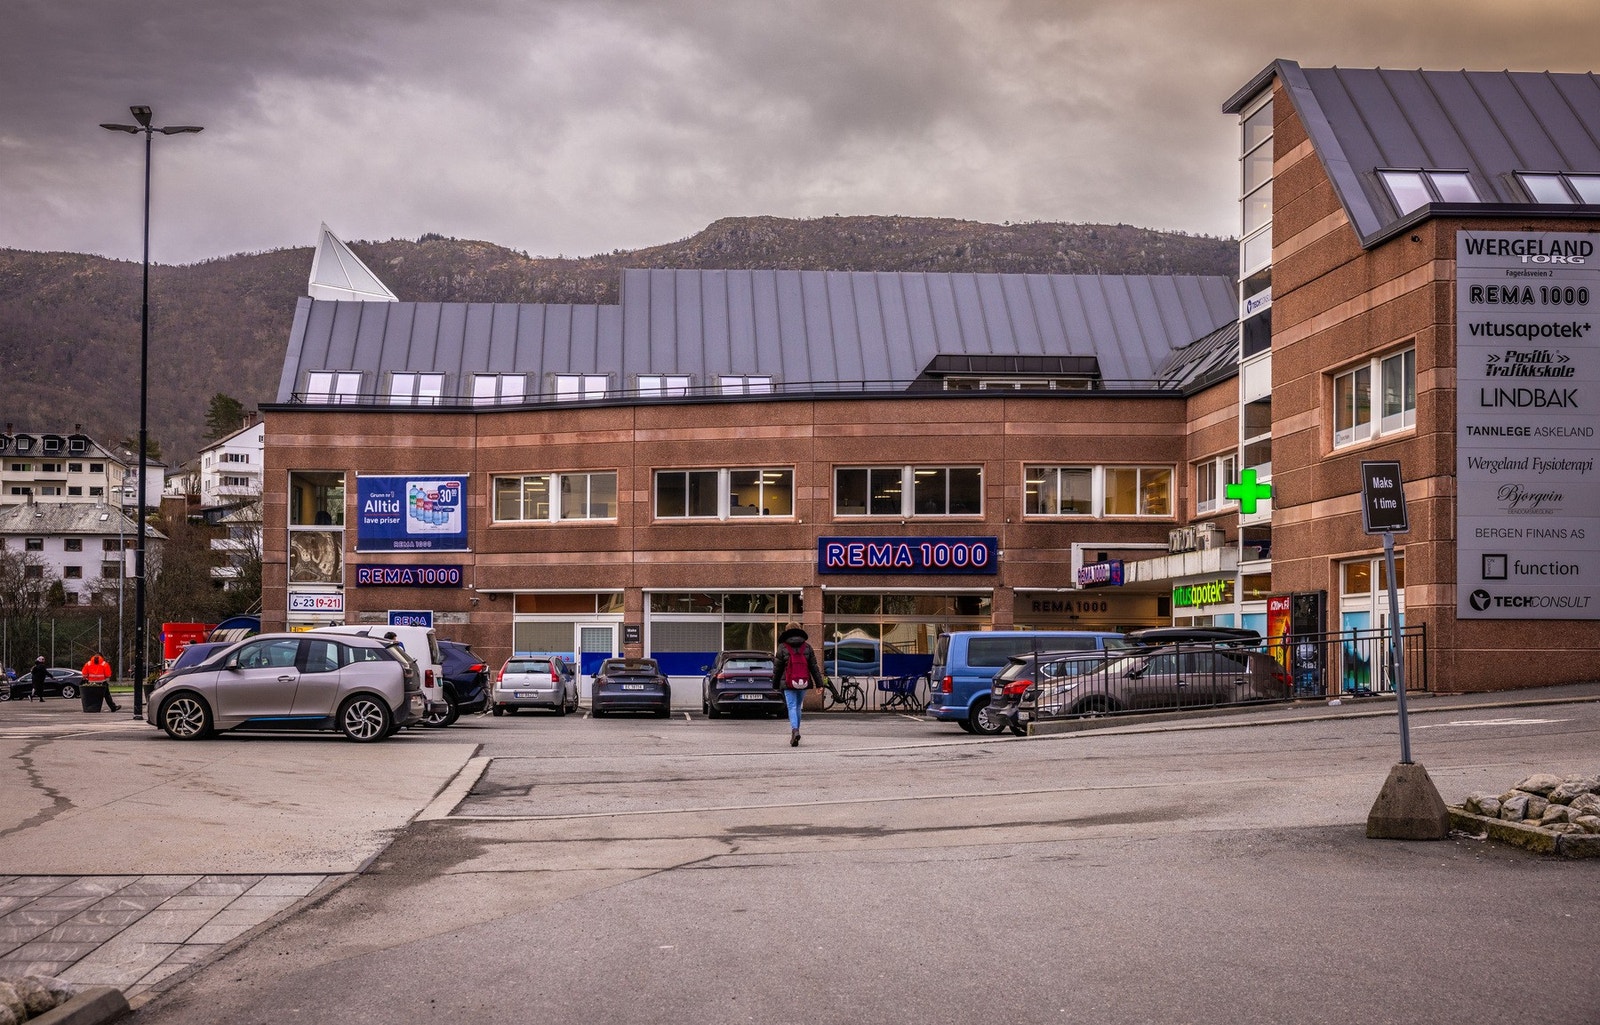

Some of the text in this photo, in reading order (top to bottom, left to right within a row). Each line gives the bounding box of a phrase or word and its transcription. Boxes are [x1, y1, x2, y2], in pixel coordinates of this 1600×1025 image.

[1465, 239, 1593, 257] WERGELAND
[1518, 255, 1585, 264] TORG
[1506, 270, 1547, 278] Fageråsveien
[1469, 285, 1590, 306] REMA 1000
[1504, 350, 1554, 364] Positiv
[1486, 364, 1575, 377] Trafikkskole
[1481, 388, 1578, 408] LINDBAK
[1466, 426, 1594, 437] TANNLEGE ASKELAND
[1468, 457, 1594, 474] Wergeland Fysioterapi
[1372, 477, 1393, 488] Maks
[440, 489, 451, 502] 30
[364, 500, 399, 512] Alltid
[1374, 498, 1396, 509] 1 time
[1475, 528, 1585, 539] BERGEN FINANS AS
[827, 543, 987, 567] REMA 1000
[1514, 560, 1579, 575] function
[358, 569, 460, 584] REMA 1000
[315, 598, 340, 608] (9-21)
[1032, 600, 1107, 611] REMA 1000
[394, 616, 427, 625] REMA
